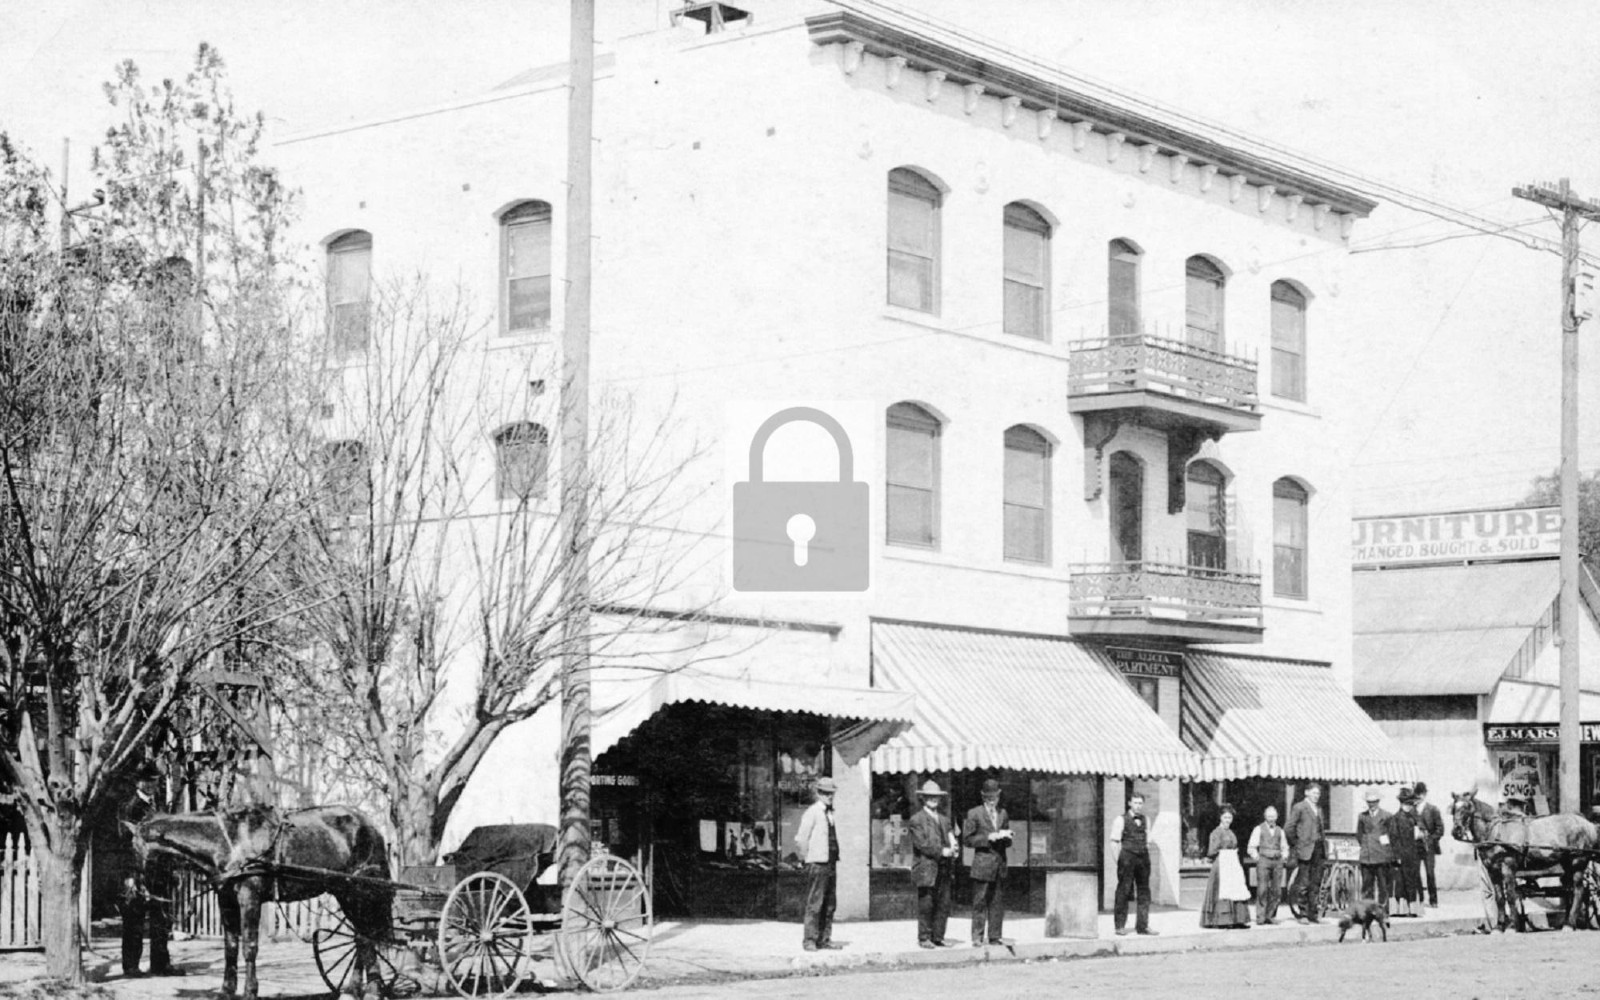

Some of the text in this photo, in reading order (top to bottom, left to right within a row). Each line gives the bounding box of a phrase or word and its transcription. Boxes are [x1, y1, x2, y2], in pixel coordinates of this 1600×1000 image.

[1479, 538, 1492, 553] &
[1496, 536, 1540, 553] SOLD
[1510, 729, 1560, 739] MARS
[1503, 783, 1536, 797] SONGS
